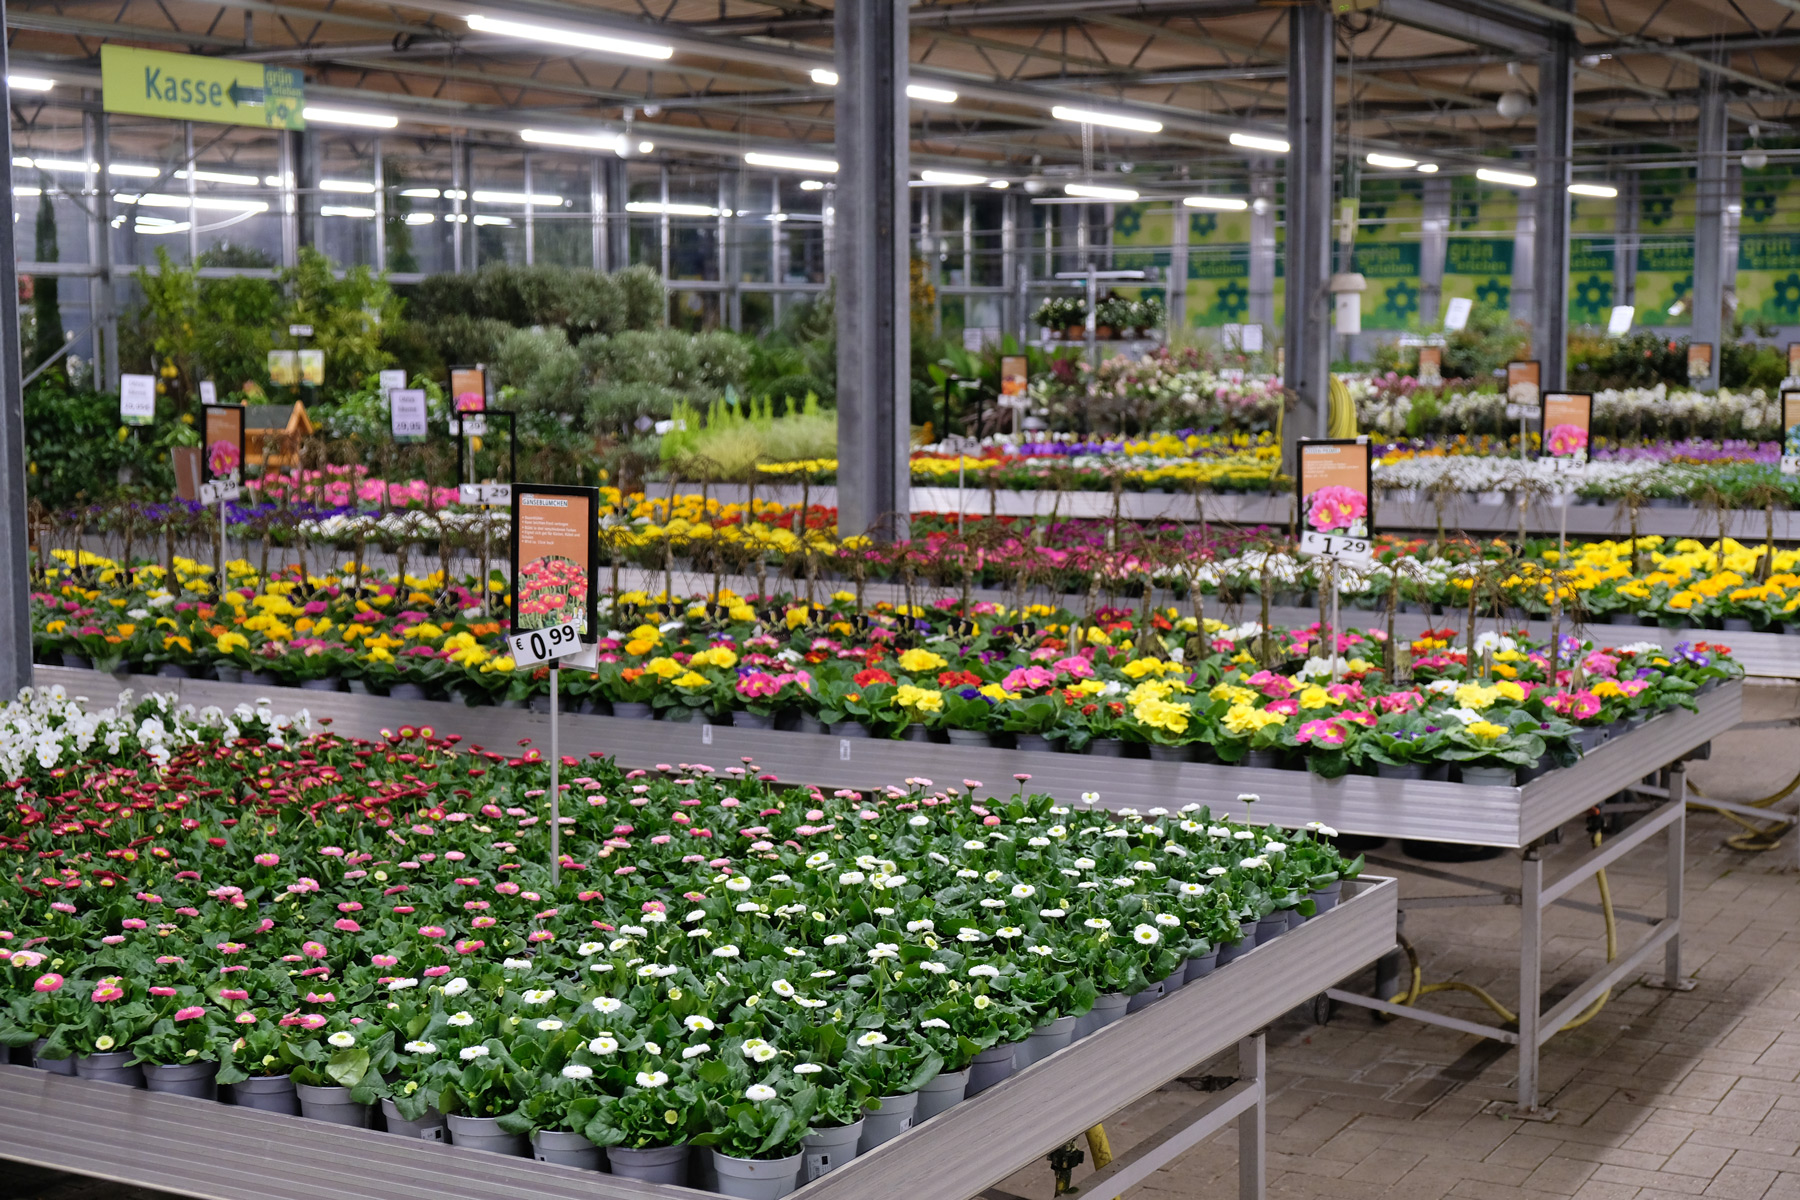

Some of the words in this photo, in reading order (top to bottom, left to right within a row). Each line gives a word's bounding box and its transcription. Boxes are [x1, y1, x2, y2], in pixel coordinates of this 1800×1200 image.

[144, 66, 222, 107] Kasse
[266, 69, 294, 88] grün
[1450, 239, 1494, 262] grün
[1743, 237, 1791, 259] grün
[1367, 262, 1414, 274] erleben
[1456, 259, 1507, 272] erleben
[212, 480, 236, 499] 1,29
[475, 487, 509, 502] 1,29
[1308, 534, 1315, 543] €
[1321, 537, 1366, 556] 1,29
[515, 637, 524, 651] €
[530, 624, 575, 660] 0,99
